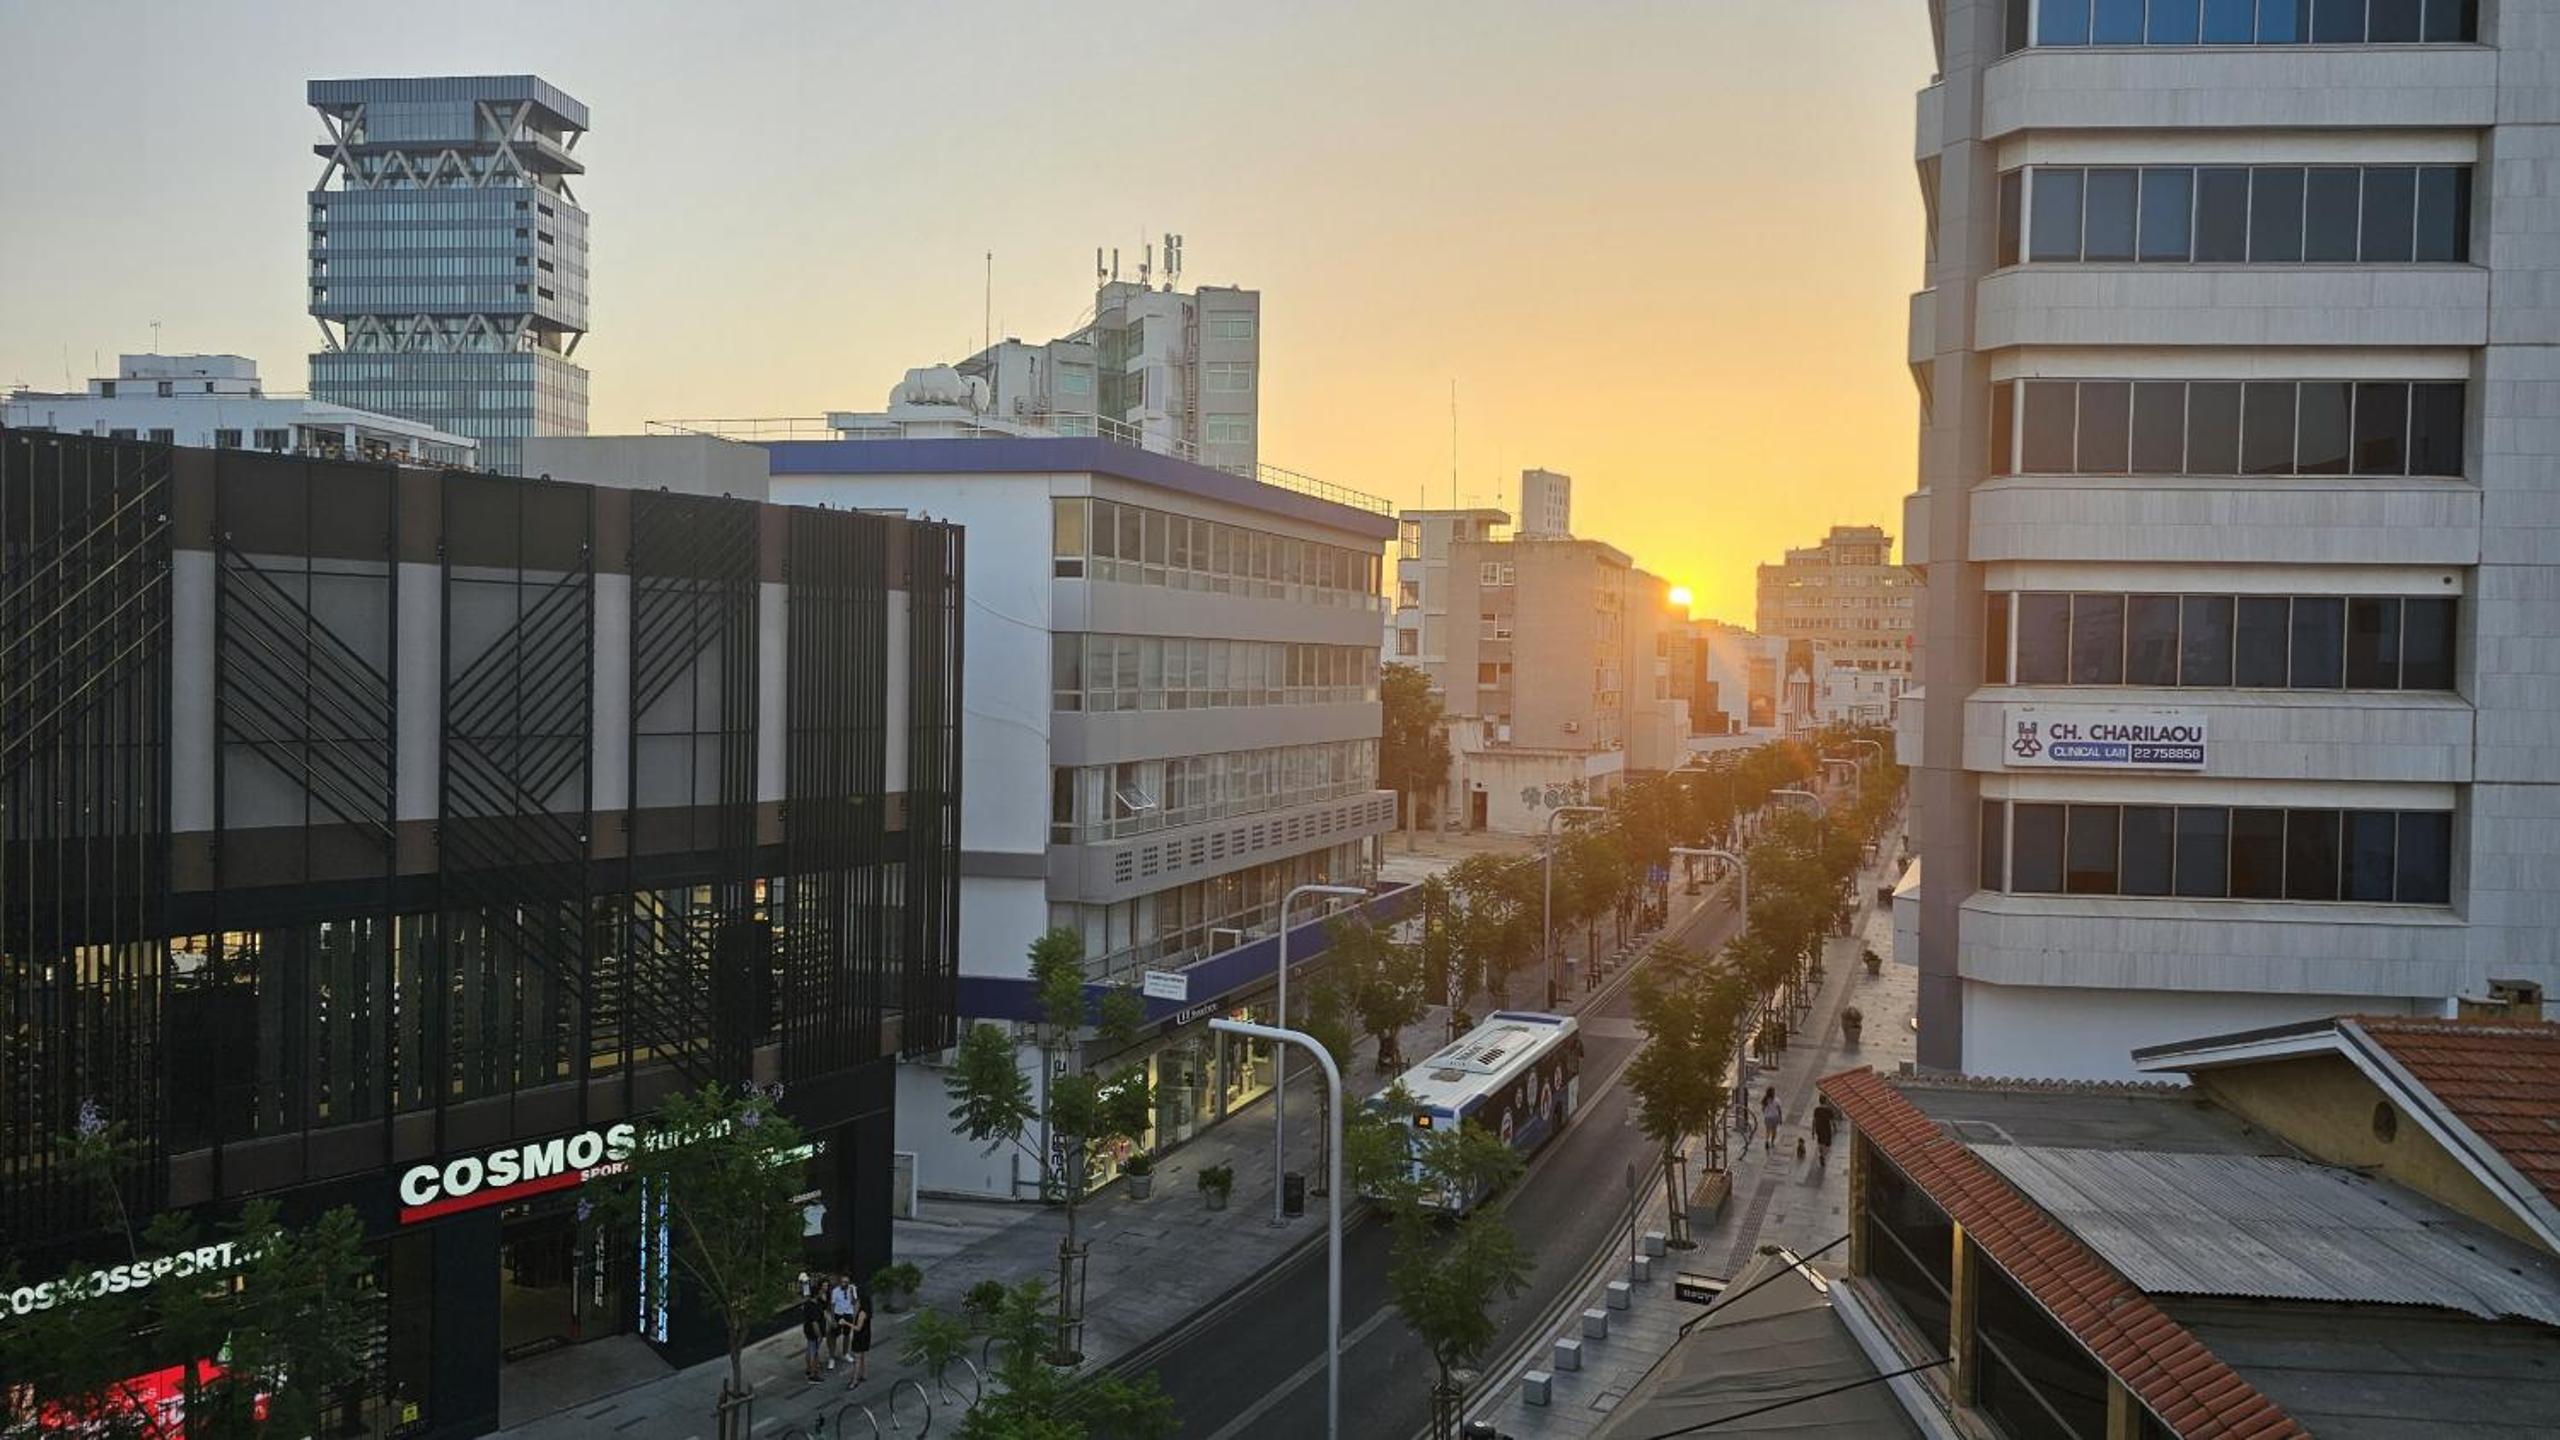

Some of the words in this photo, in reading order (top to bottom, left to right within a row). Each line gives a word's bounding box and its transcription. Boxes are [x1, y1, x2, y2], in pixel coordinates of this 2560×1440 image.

[2050, 723, 2082, 740] CH.
[2090, 724, 2202, 743] CHARILAOU
[2054, 747, 2100, 757] CLINICAL
[400, 1124, 636, 1206] COSMOS
